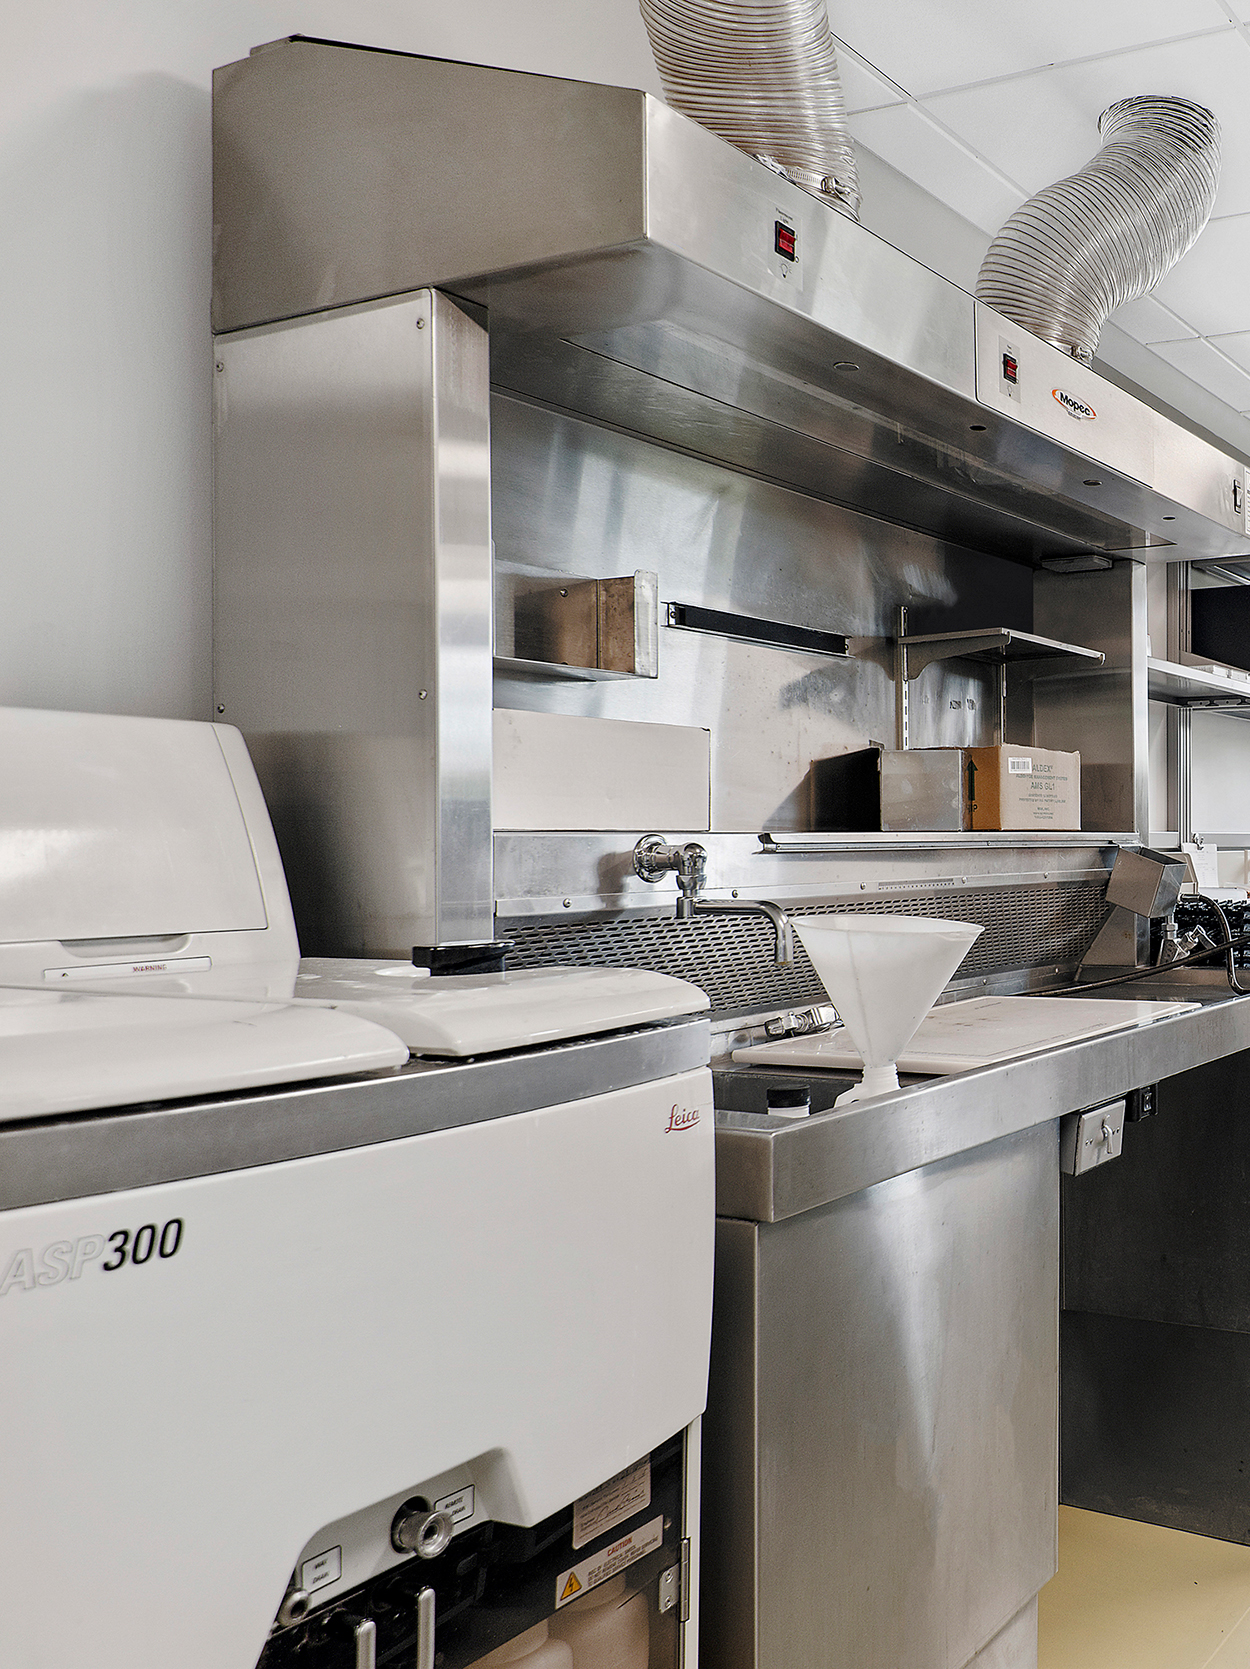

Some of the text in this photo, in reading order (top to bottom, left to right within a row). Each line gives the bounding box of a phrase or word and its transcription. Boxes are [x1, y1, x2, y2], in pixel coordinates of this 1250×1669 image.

[1060, 392, 1090, 416] Mopec
[1030, 782, 1044, 790] AMS
[133, 964, 167, 973] WARNING
[664, 1104, 701, 1133] Leica
[0, 1218, 183, 1296] ASP300
[607, 1536, 633, 1557] CAUTION
